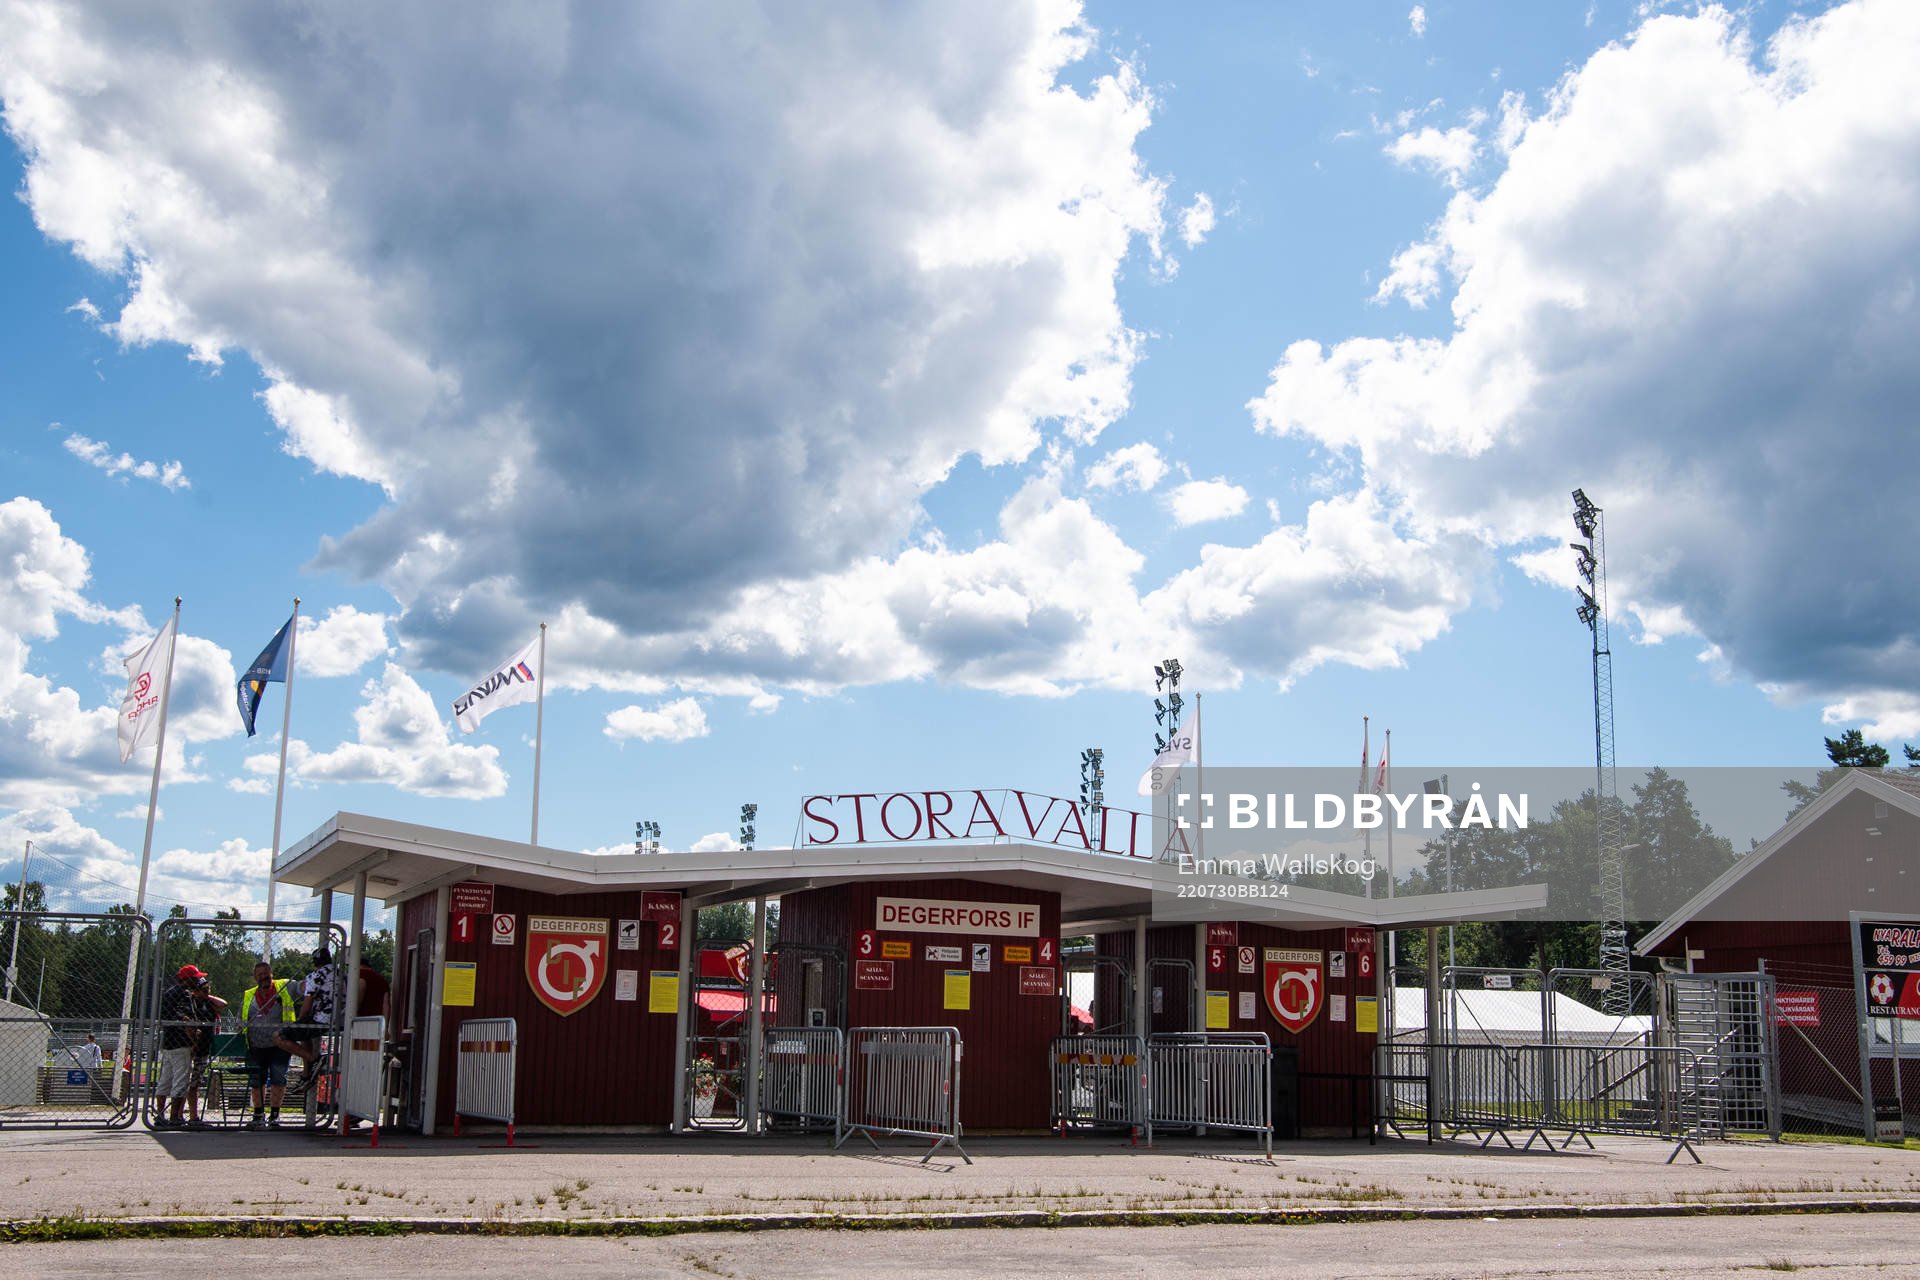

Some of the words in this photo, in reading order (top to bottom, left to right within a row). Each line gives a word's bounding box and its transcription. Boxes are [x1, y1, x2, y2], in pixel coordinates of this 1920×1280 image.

[803, 789, 1008, 844] STORA
[1011, 789, 1195, 867] VALLA
[458, 916, 467, 937] 1
[532, 920, 604, 932] DEGERFORS
[882, 904, 1011, 928] DEGERFORS
[1018, 911, 1035, 929] IF
[661, 924, 675, 945] 2
[860, 934, 872, 954] 3
[1041, 941, 1052, 961] 4
[1212, 949, 1221, 968] 5
[1267, 951, 1320, 962] DEGERFORS
[1361, 955, 1370, 973] 6
